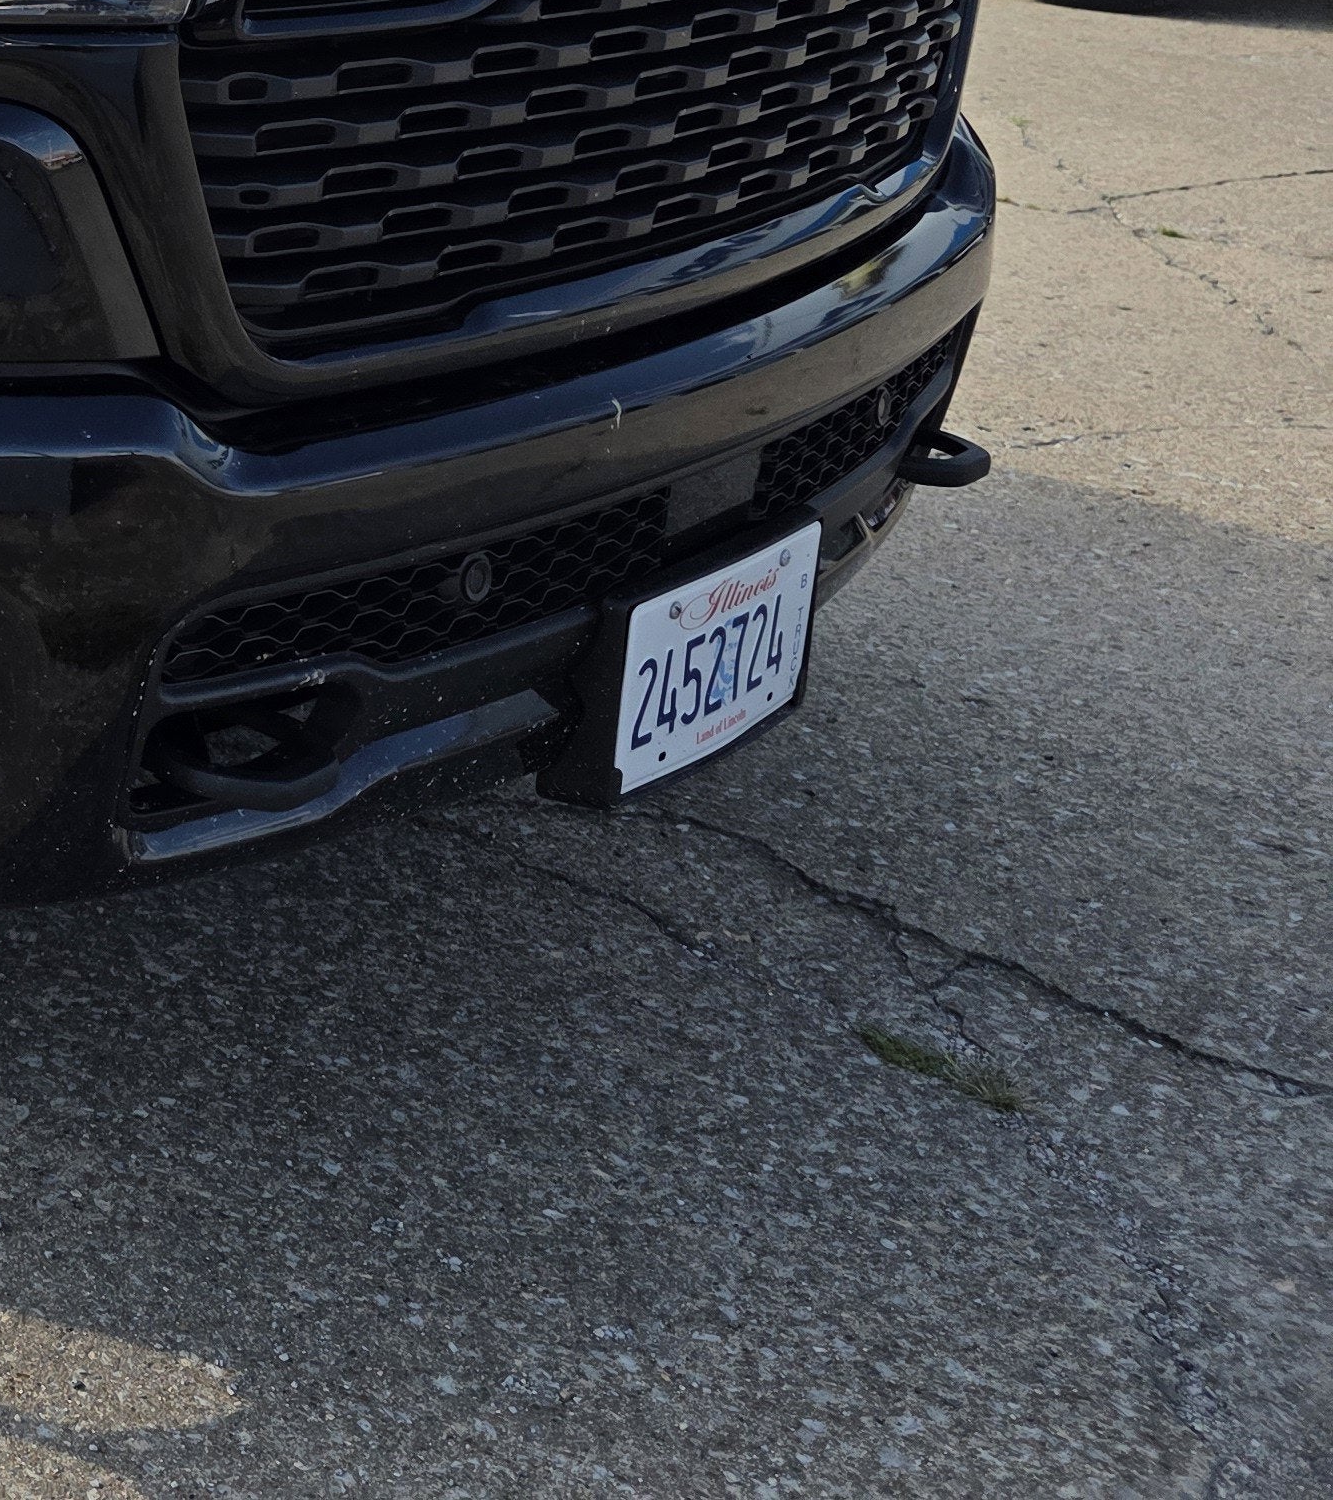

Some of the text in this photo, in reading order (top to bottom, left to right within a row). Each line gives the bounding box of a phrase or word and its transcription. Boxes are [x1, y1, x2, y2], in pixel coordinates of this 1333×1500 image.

[679, 566, 782, 631] Illinois
[631, 594, 783, 750] 2452724
[696, 724, 715, 745] Land
